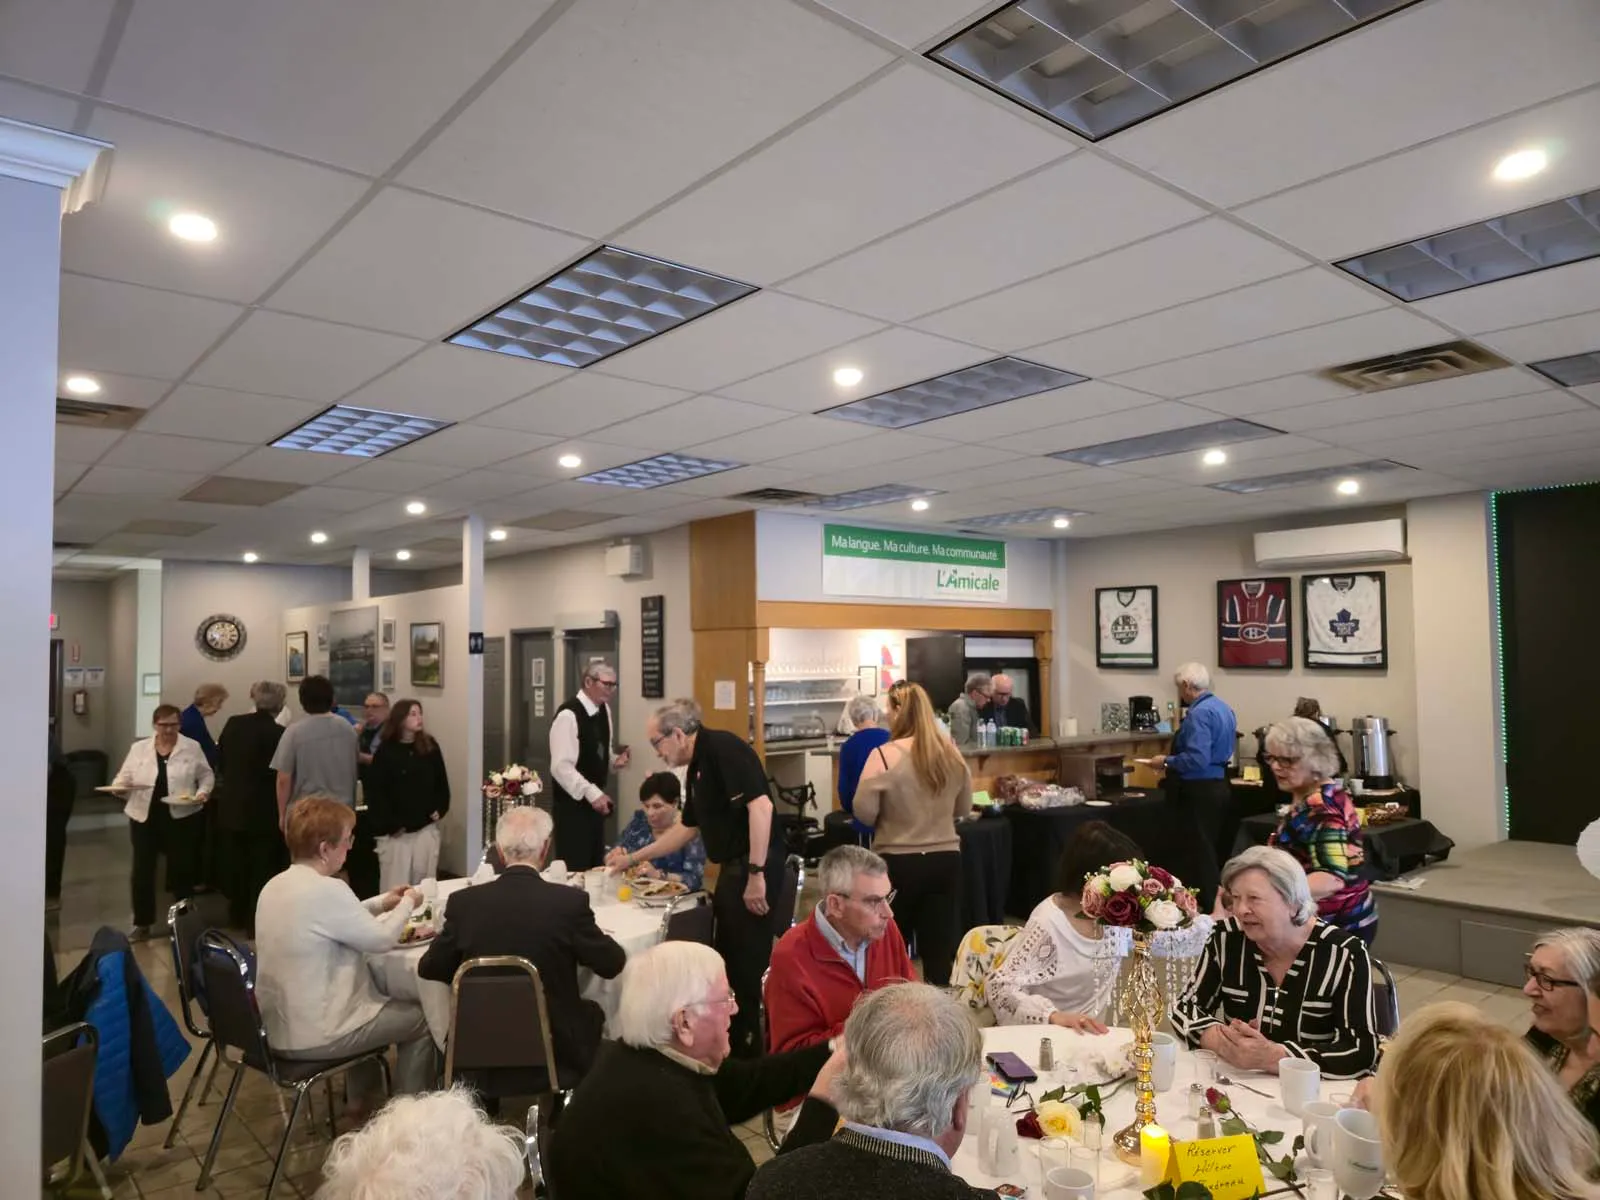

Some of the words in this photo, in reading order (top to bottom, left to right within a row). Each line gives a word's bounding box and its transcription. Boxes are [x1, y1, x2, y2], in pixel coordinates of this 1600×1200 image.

[831, 535, 848, 549] Ma
[848, 536, 881, 553] langue.
[883, 539, 898, 553] Ma
[899, 541, 930, 555] culture.
[932, 543, 945, 556] Ma
[947, 548, 999, 561] communauté.
[1186, 1142, 1237, 1157] Réserver
